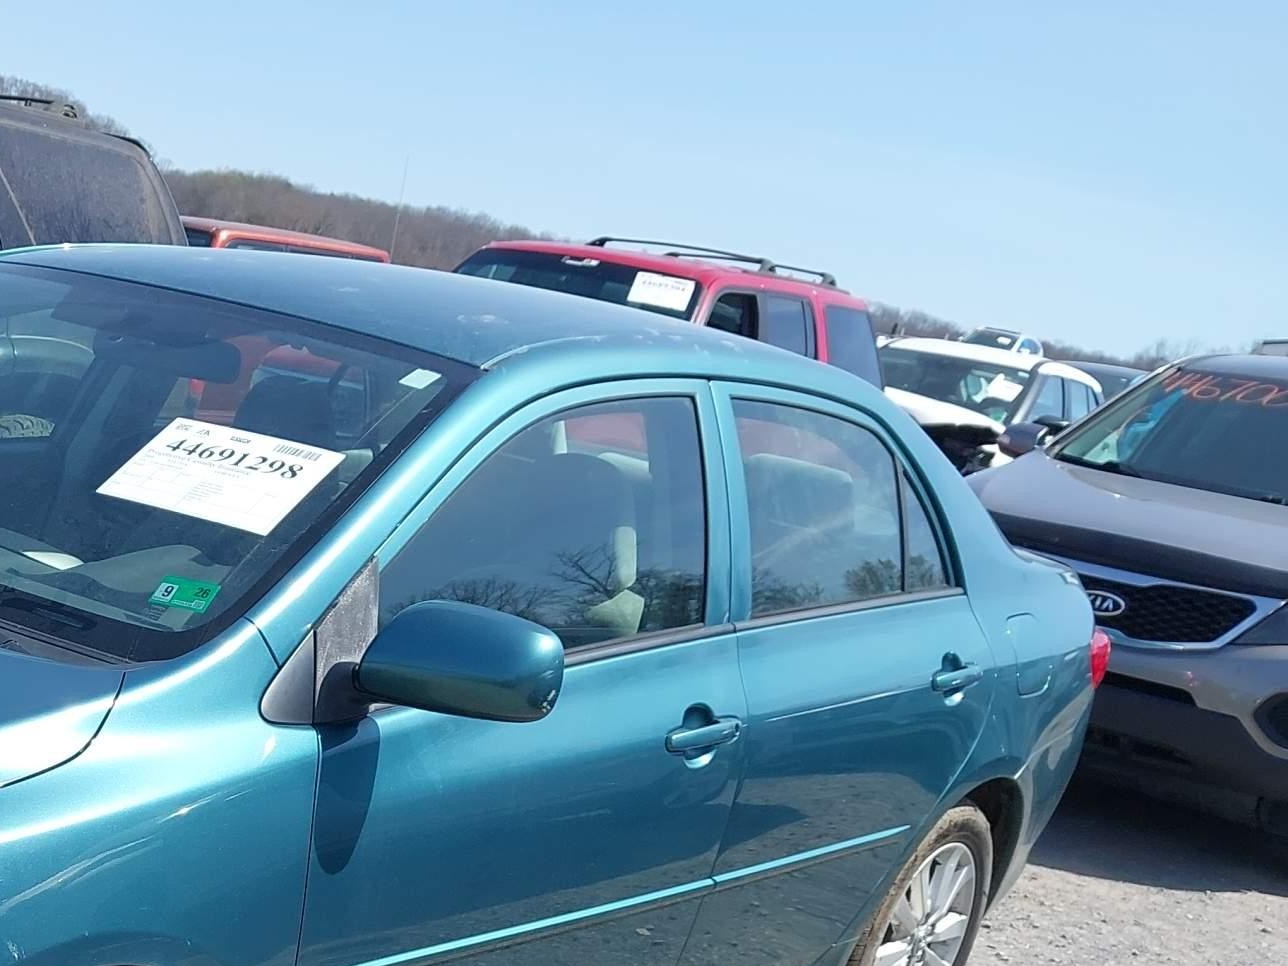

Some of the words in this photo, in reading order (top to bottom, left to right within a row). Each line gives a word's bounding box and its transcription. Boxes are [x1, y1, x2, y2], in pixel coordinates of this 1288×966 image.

[166, 438, 304, 479] 44691298
[162, 585, 175, 598] 9
[193, 587, 211, 599] 26
